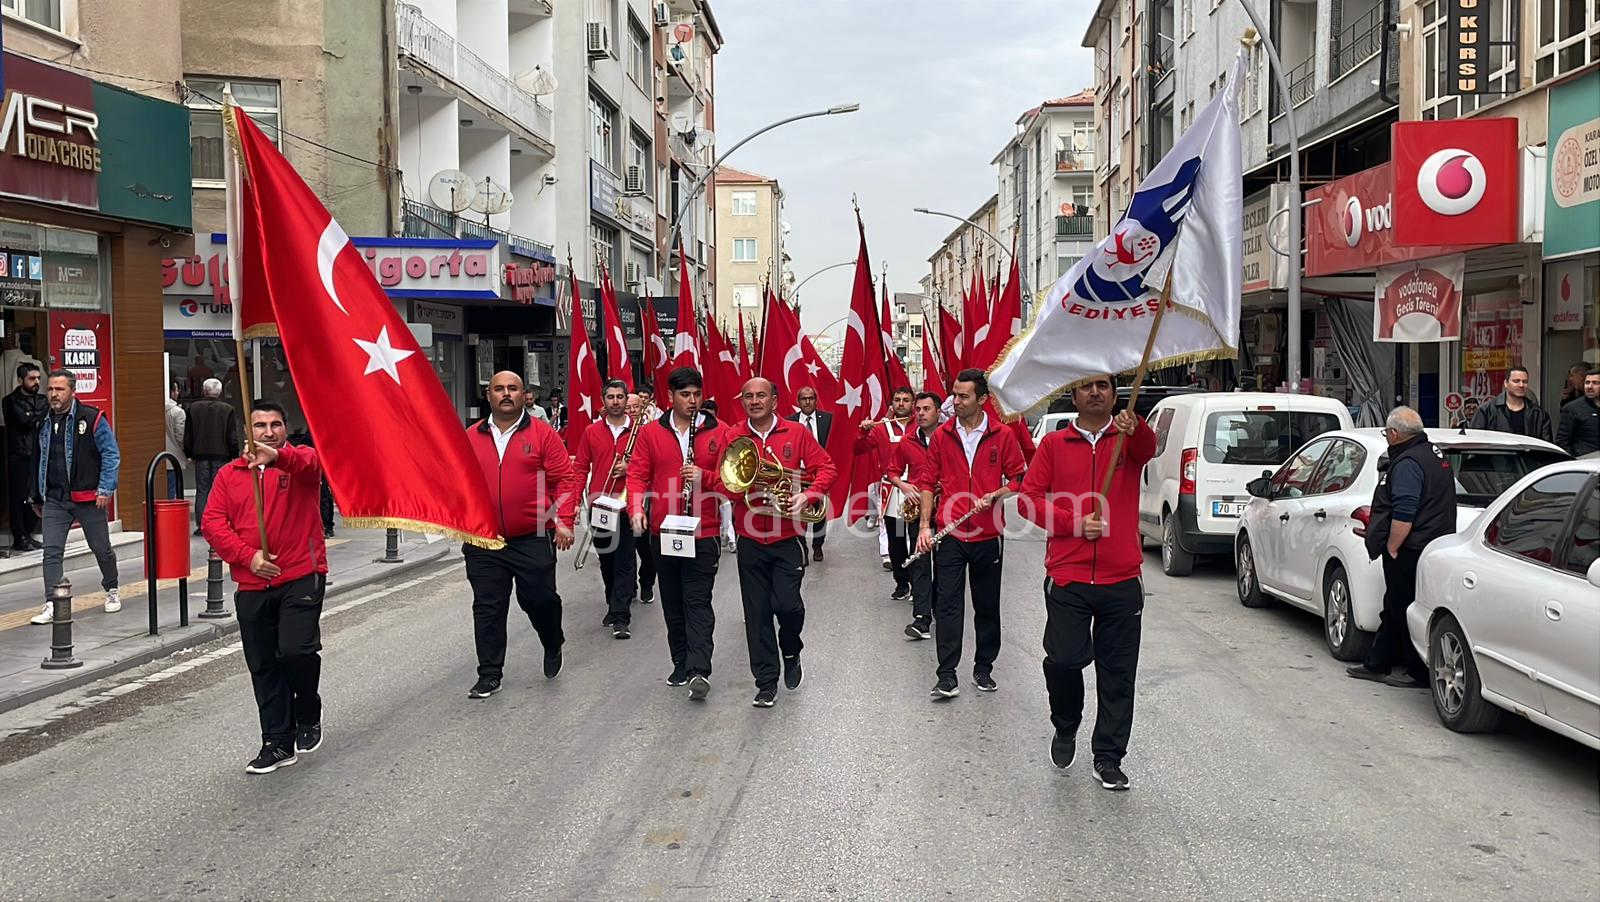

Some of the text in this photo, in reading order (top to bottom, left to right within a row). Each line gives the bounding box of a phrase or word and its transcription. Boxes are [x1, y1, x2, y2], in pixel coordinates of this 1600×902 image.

[1458, 16, 1478, 91] KURSU
[66, 335, 95, 346] EFSANE
[64, 351, 95, 365] KASIM
[1219, 504, 1230, 513] 70
